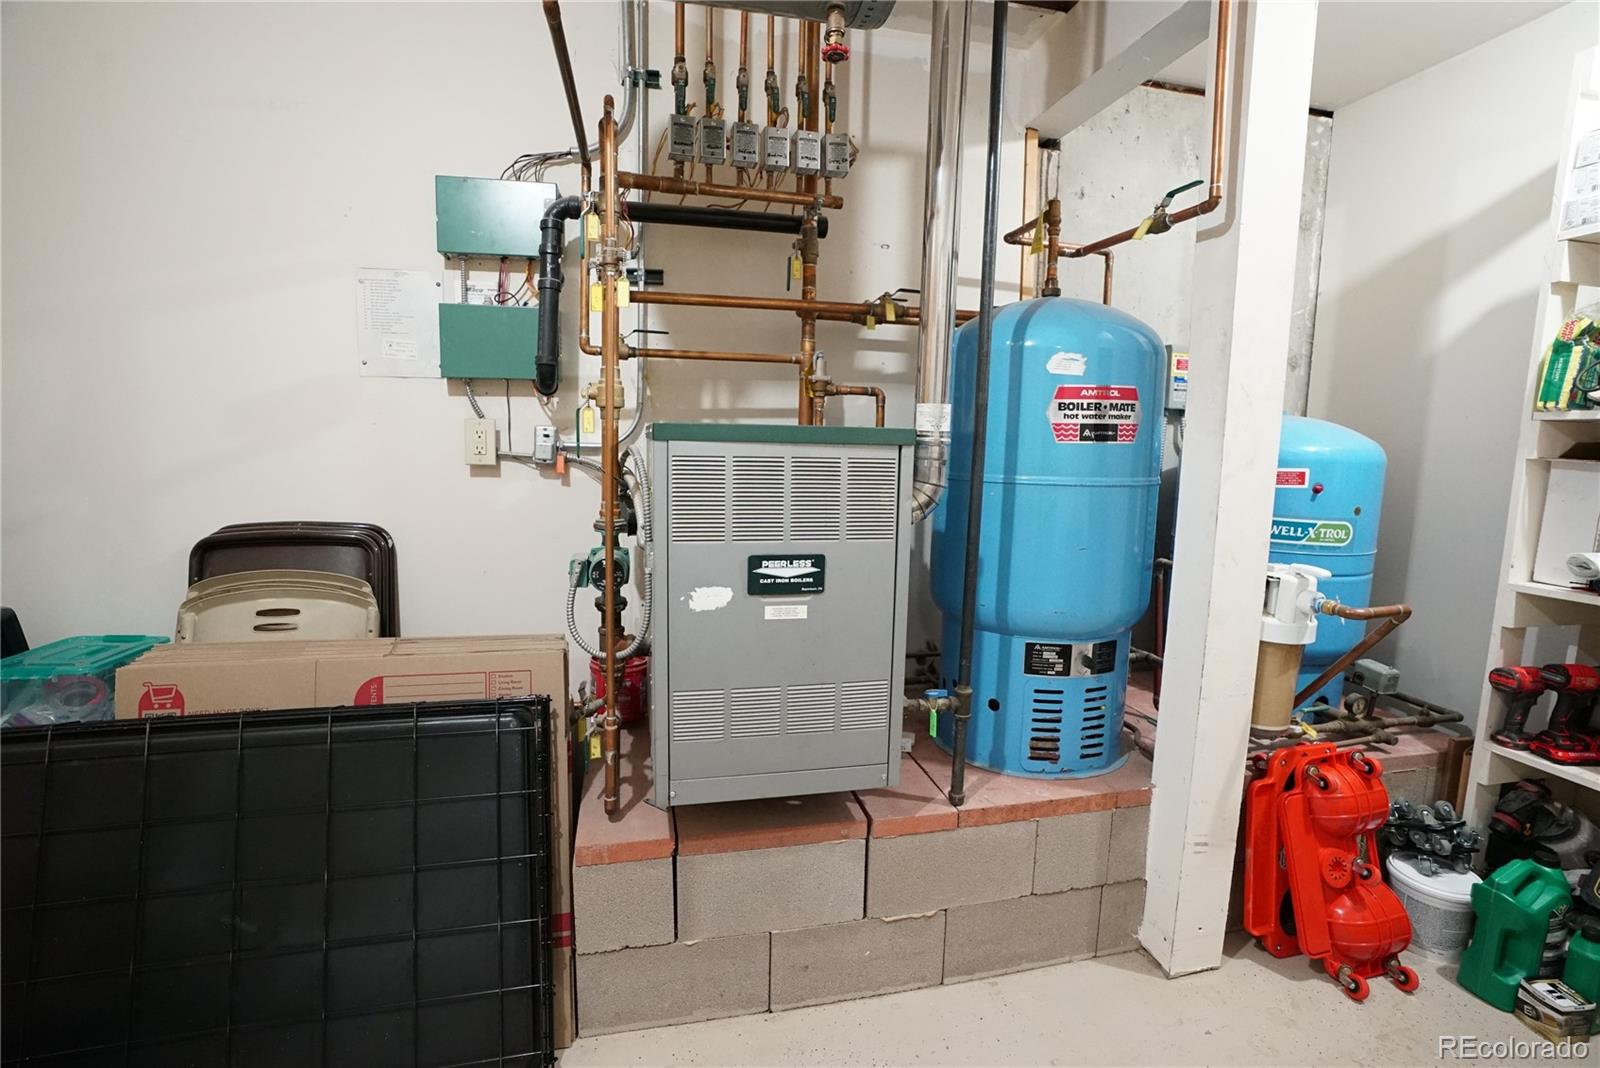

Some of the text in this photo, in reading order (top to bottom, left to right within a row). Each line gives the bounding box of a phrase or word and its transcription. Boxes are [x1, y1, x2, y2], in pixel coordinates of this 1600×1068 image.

[1058, 402, 1136, 412] BOILER MATE
[761, 559, 812, 568] PEERLESS
